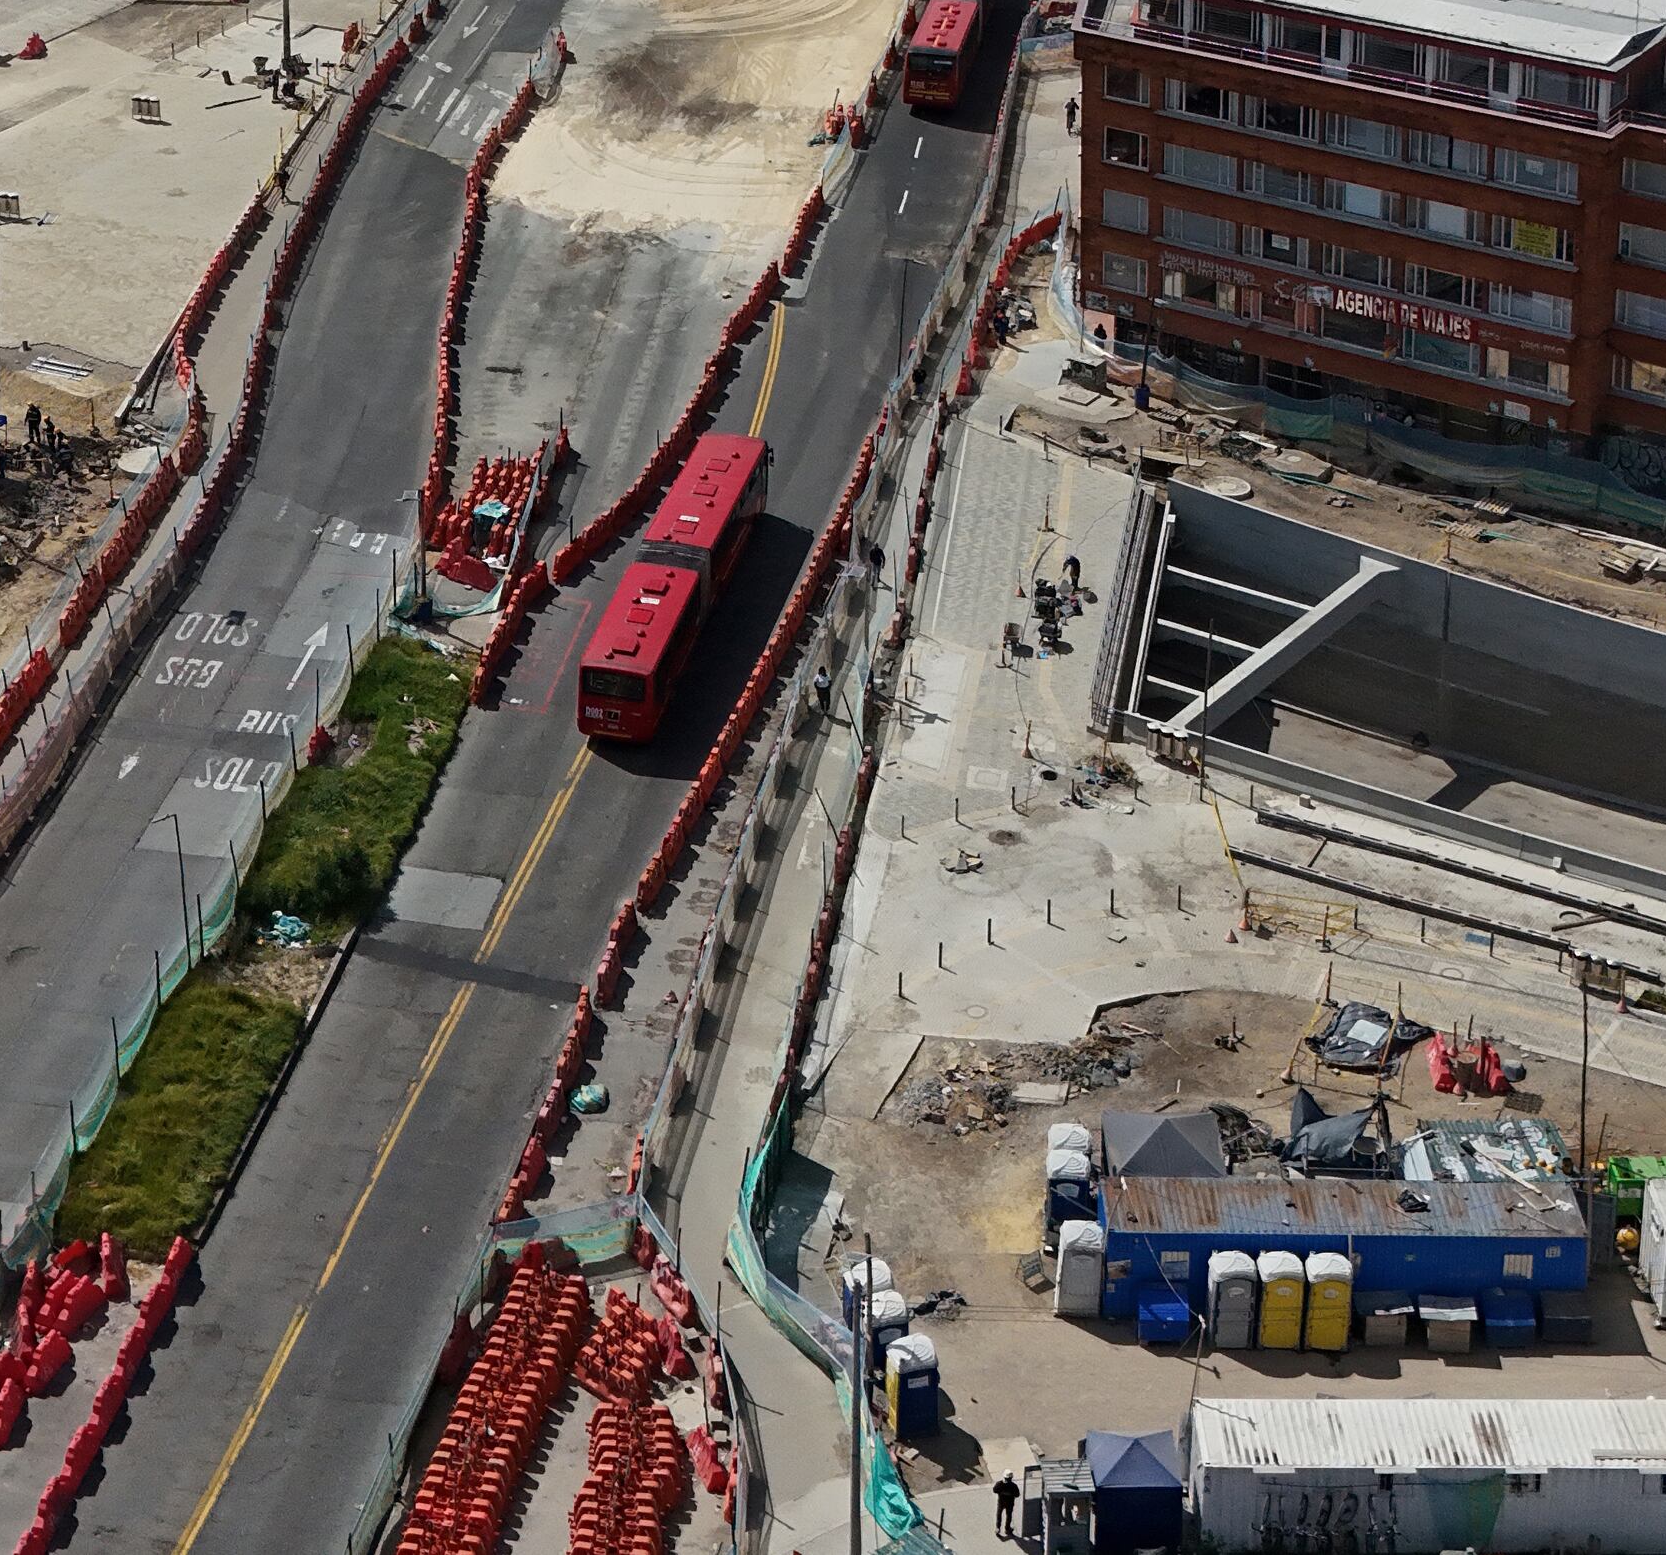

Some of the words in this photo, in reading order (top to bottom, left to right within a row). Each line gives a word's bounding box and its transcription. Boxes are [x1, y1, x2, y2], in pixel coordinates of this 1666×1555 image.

[1335, 288, 1395, 323] AGENCIA
[1400, 303, 1418, 329] DE
[1421, 308, 1472, 341] VIAJES
[193, 757, 283, 793] SOLO
